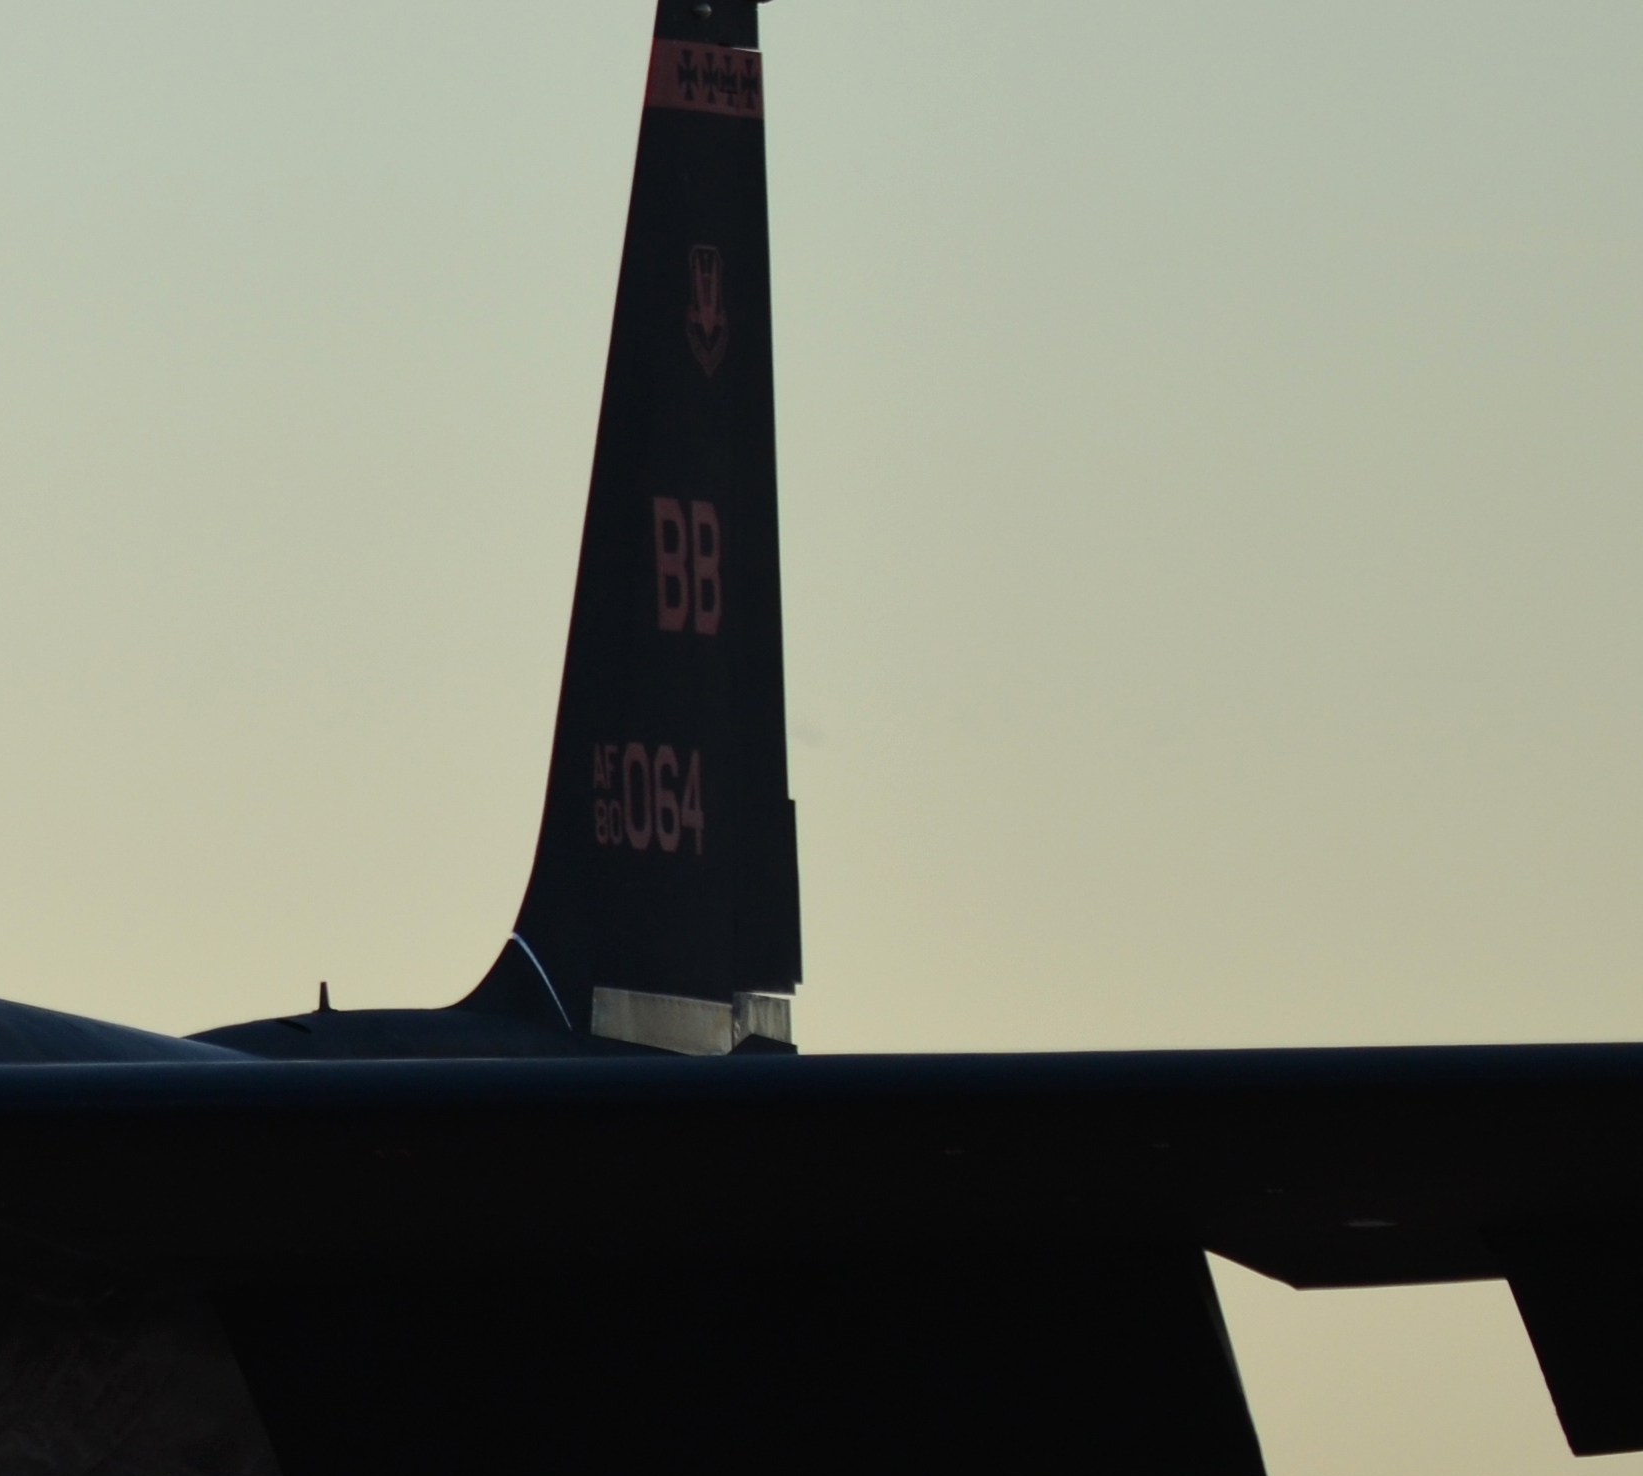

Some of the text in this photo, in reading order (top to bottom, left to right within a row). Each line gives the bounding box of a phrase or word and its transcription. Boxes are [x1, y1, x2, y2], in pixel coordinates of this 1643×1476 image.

[652, 496, 721, 635] BB
[592, 743, 619, 790] AF
[623, 742, 704, 856] 064
[594, 799, 622, 846] 80
